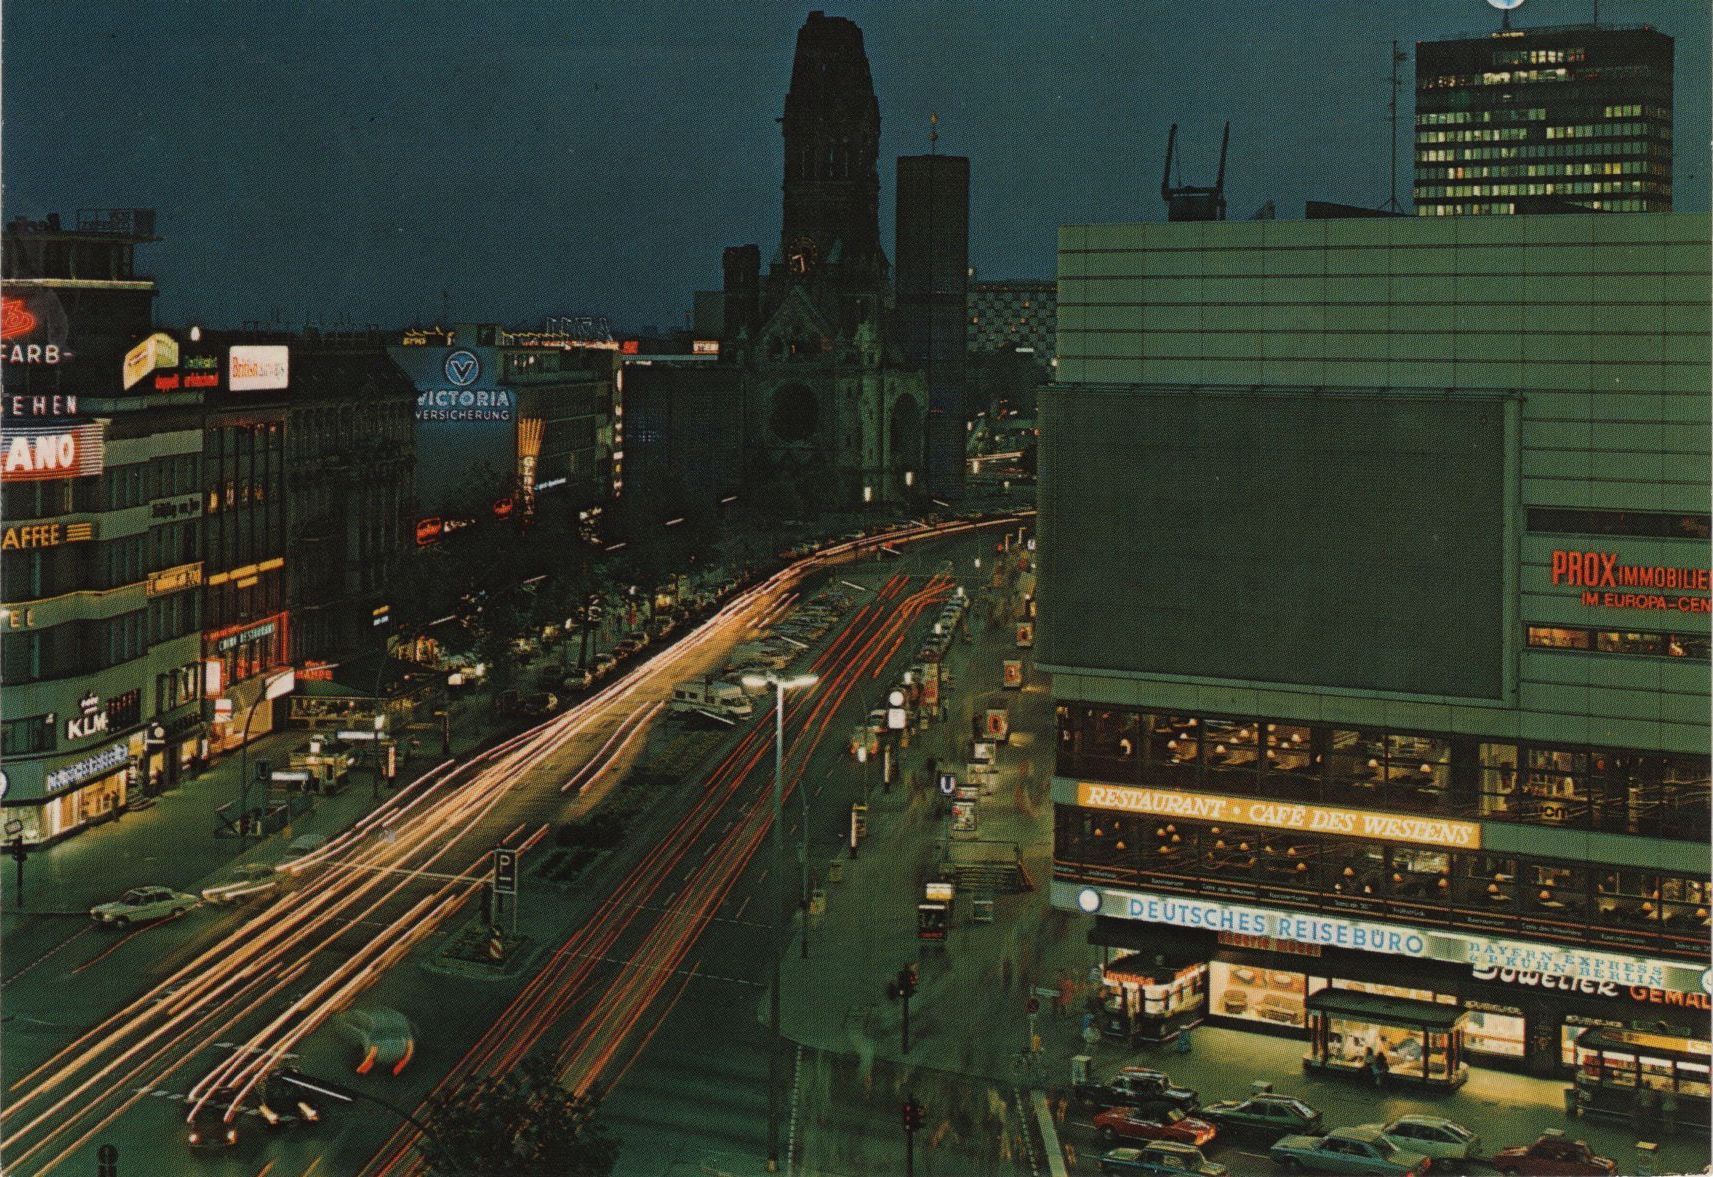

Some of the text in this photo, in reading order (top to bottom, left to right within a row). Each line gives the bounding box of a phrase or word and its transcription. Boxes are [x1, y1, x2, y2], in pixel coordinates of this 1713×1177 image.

[1, 395, 77, 416] EHEN
[417, 390, 510, 407] VICTORIA
[416, 409, 510, 421] VERSICHERUNG
[2, 524, 60, 549] AFFEE
[1552, 550, 1712, 590] PROX IMMOBILIE
[1580, 591, 1712, 613] IM EUROPA-CEN
[68, 711, 108, 740] KLM
[941, 774, 956, 794] U
[1088, 785, 1473, 845] RESTAURANT CAFÉ DES WESTENS
[1129, 898, 1266, 933] DEUTSCHES
[1278, 917, 1424, 954] REISEBÜRO
[1468, 942, 1663, 977] BAYERN EXPRESS
[1579, 966, 1663, 988] BERLIN
